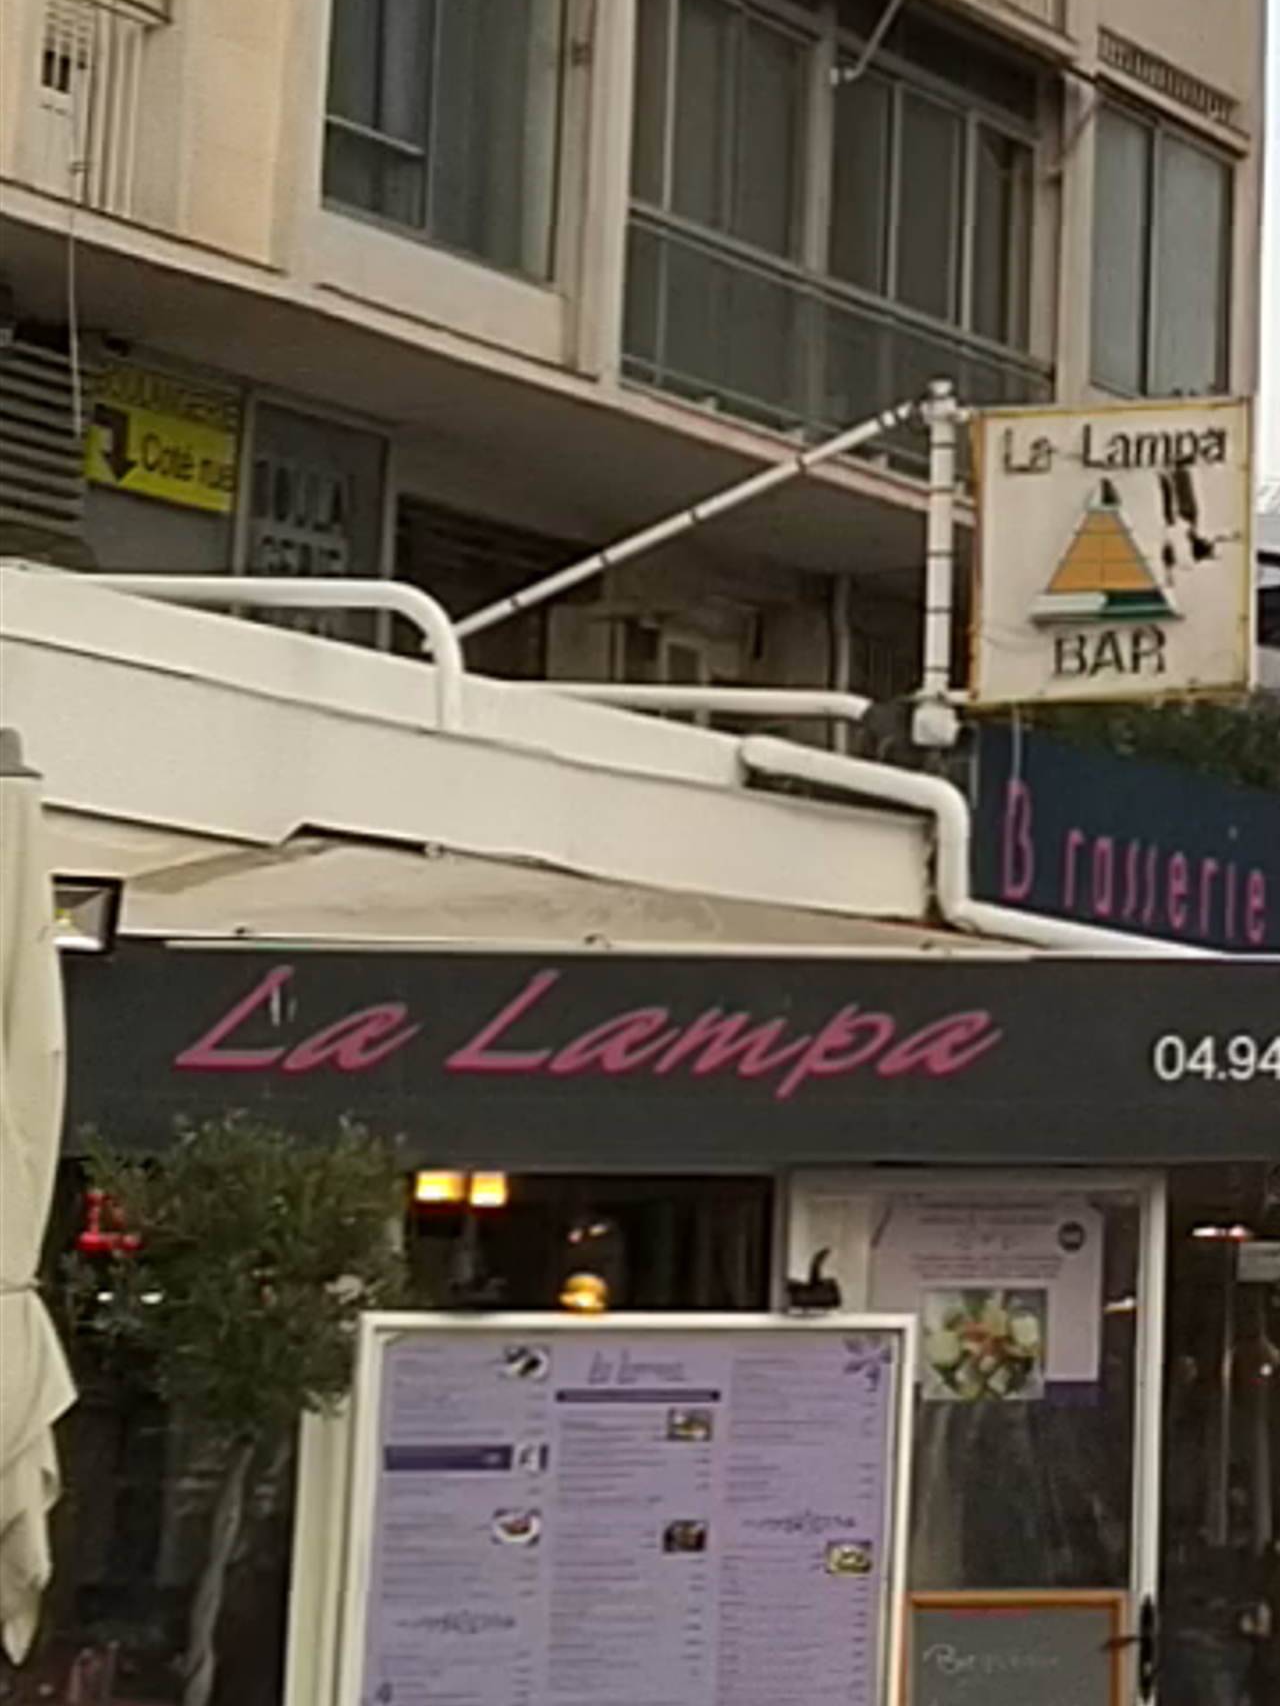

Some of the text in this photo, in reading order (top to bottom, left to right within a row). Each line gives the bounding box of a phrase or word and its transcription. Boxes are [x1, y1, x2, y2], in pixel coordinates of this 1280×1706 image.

[1004, 423, 1227, 474] La Lampa
[1053, 626, 1166, 677] BAR
[1002, 779, 1266, 945] Brasserie
[174, 965, 421, 1074] La
[444, 967, 1003, 1098] Lampa
